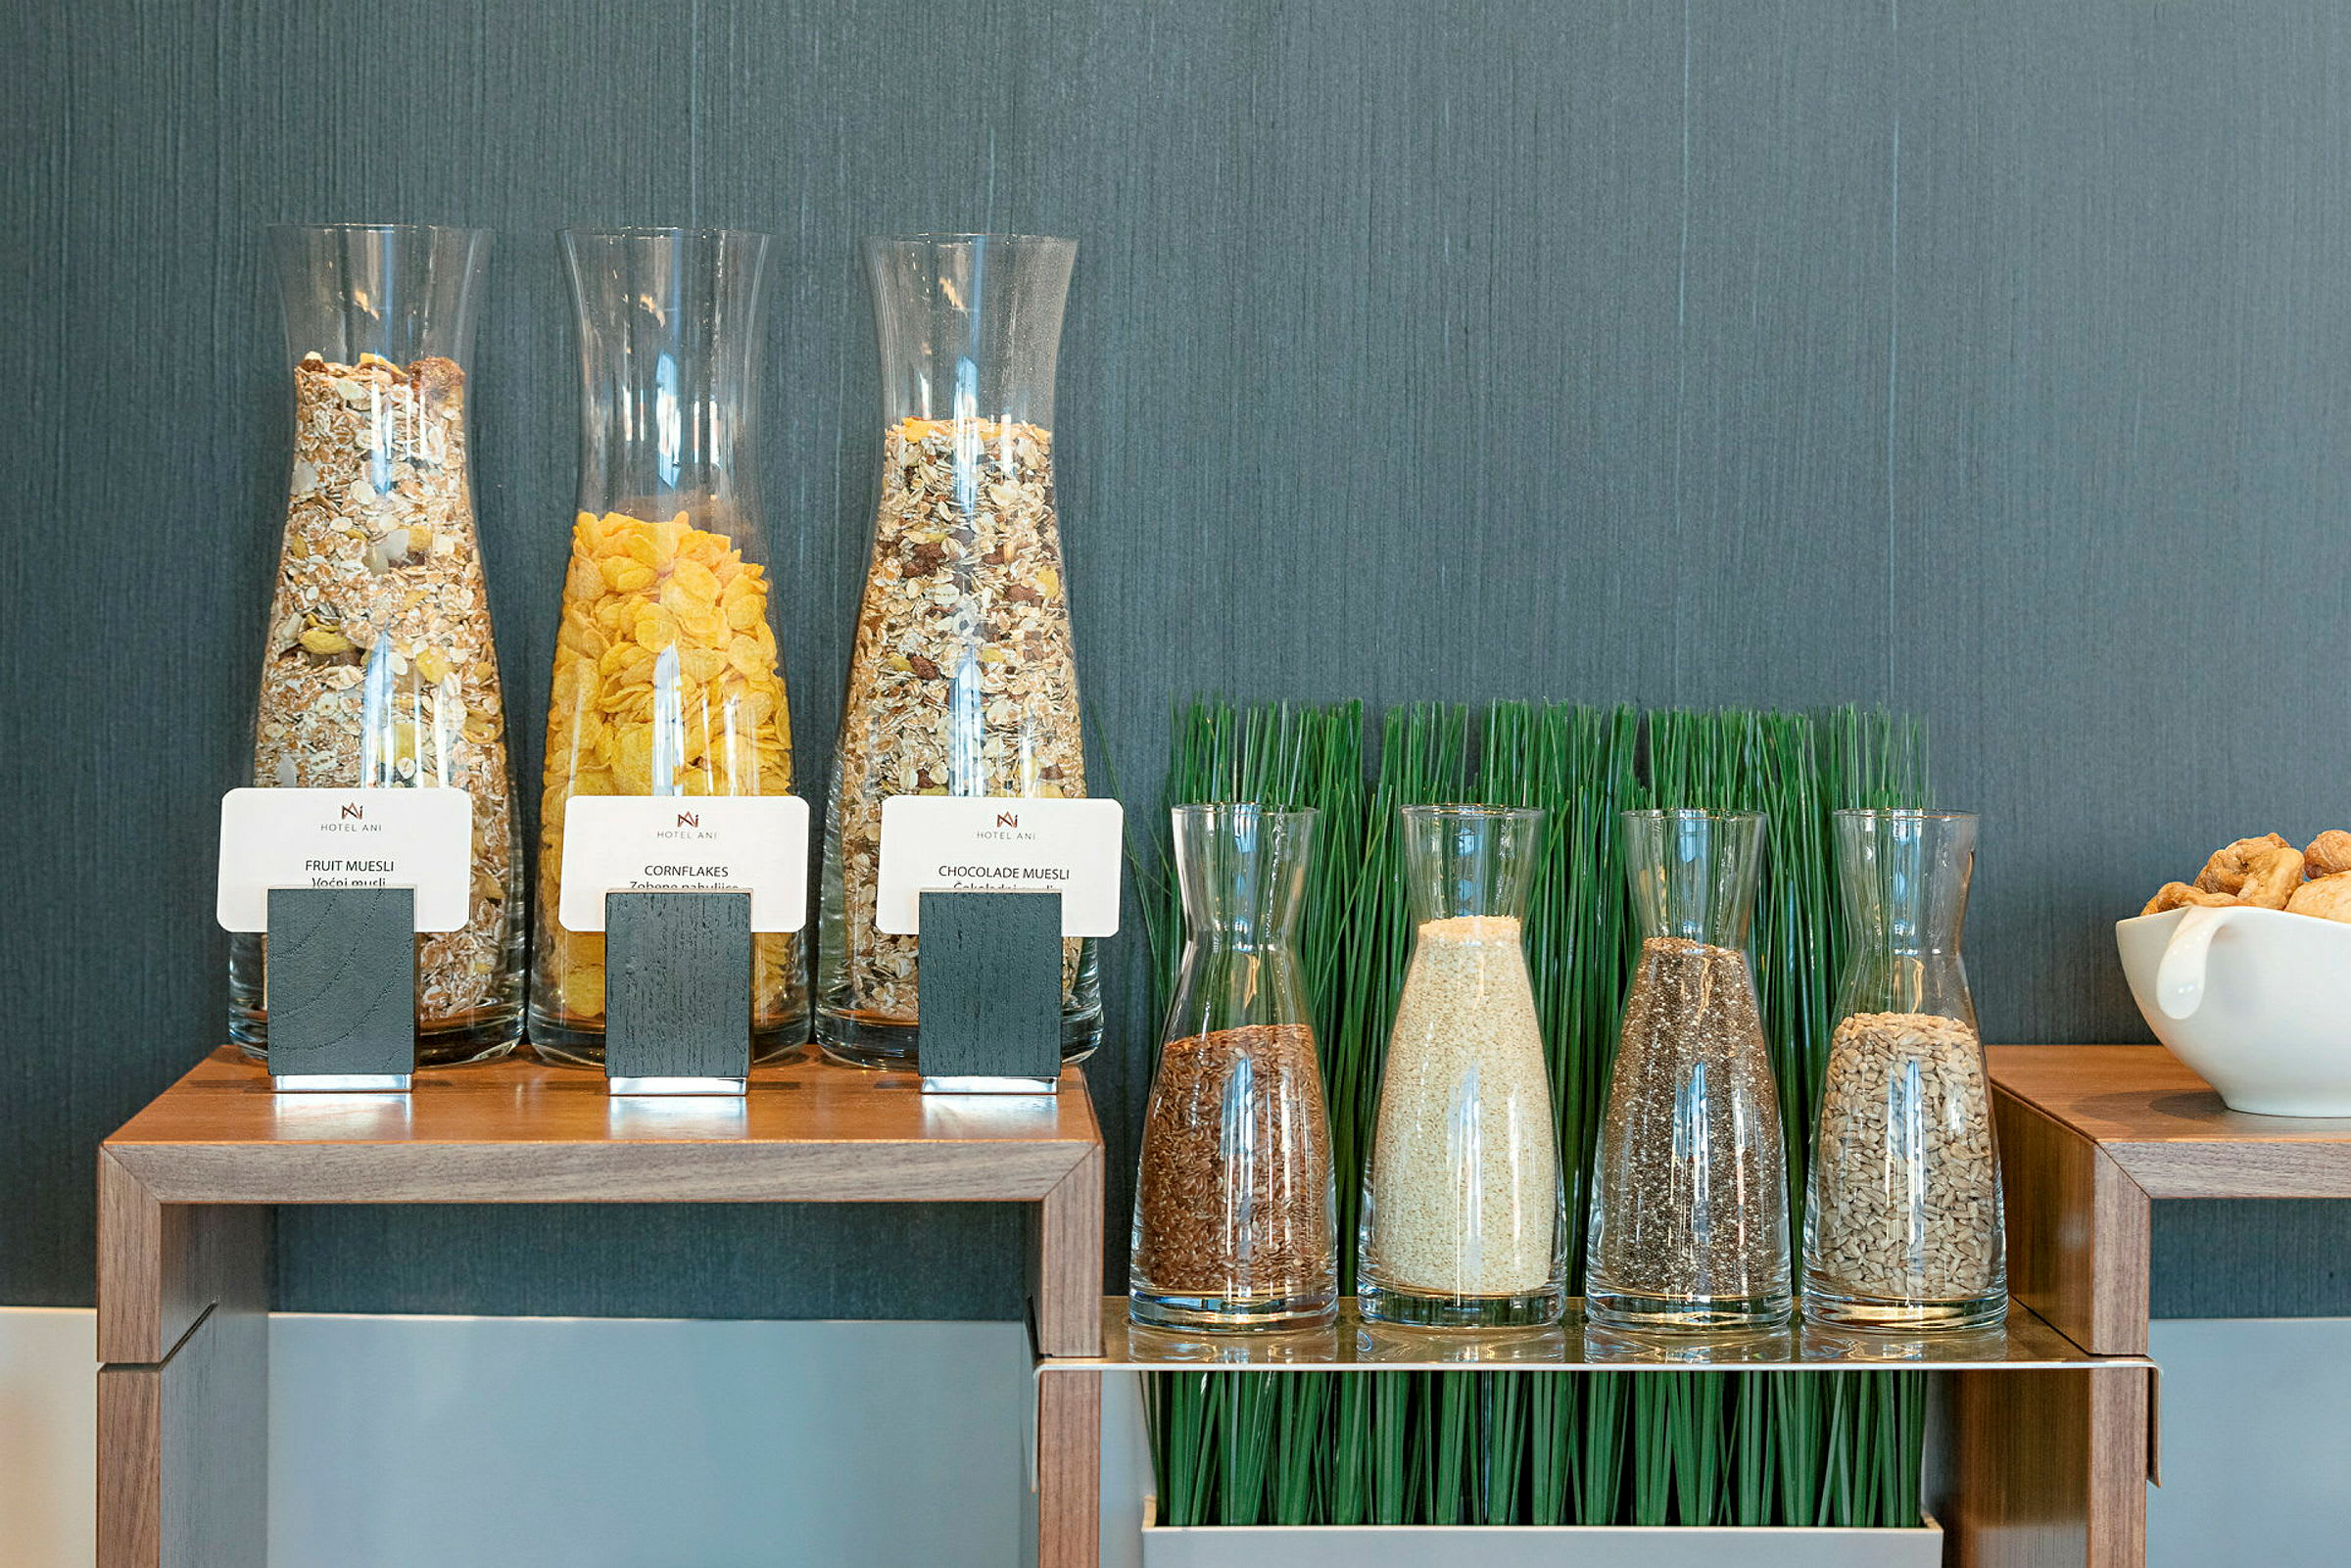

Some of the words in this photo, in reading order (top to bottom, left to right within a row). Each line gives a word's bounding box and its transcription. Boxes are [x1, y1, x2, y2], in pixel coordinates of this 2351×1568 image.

[320, 824, 358, 832] HOTEL
[656, 831, 692, 839] HOTEL
[977, 831, 1012, 840] HOTEL
[305, 859, 344, 872] FRUIT
[345, 860, 395, 873] MUESLI
[644, 865, 729, 878] CORNFLAKES
[937, 865, 1020, 879] CHOCOLADE
[1022, 868, 1070, 880] MUESLI
